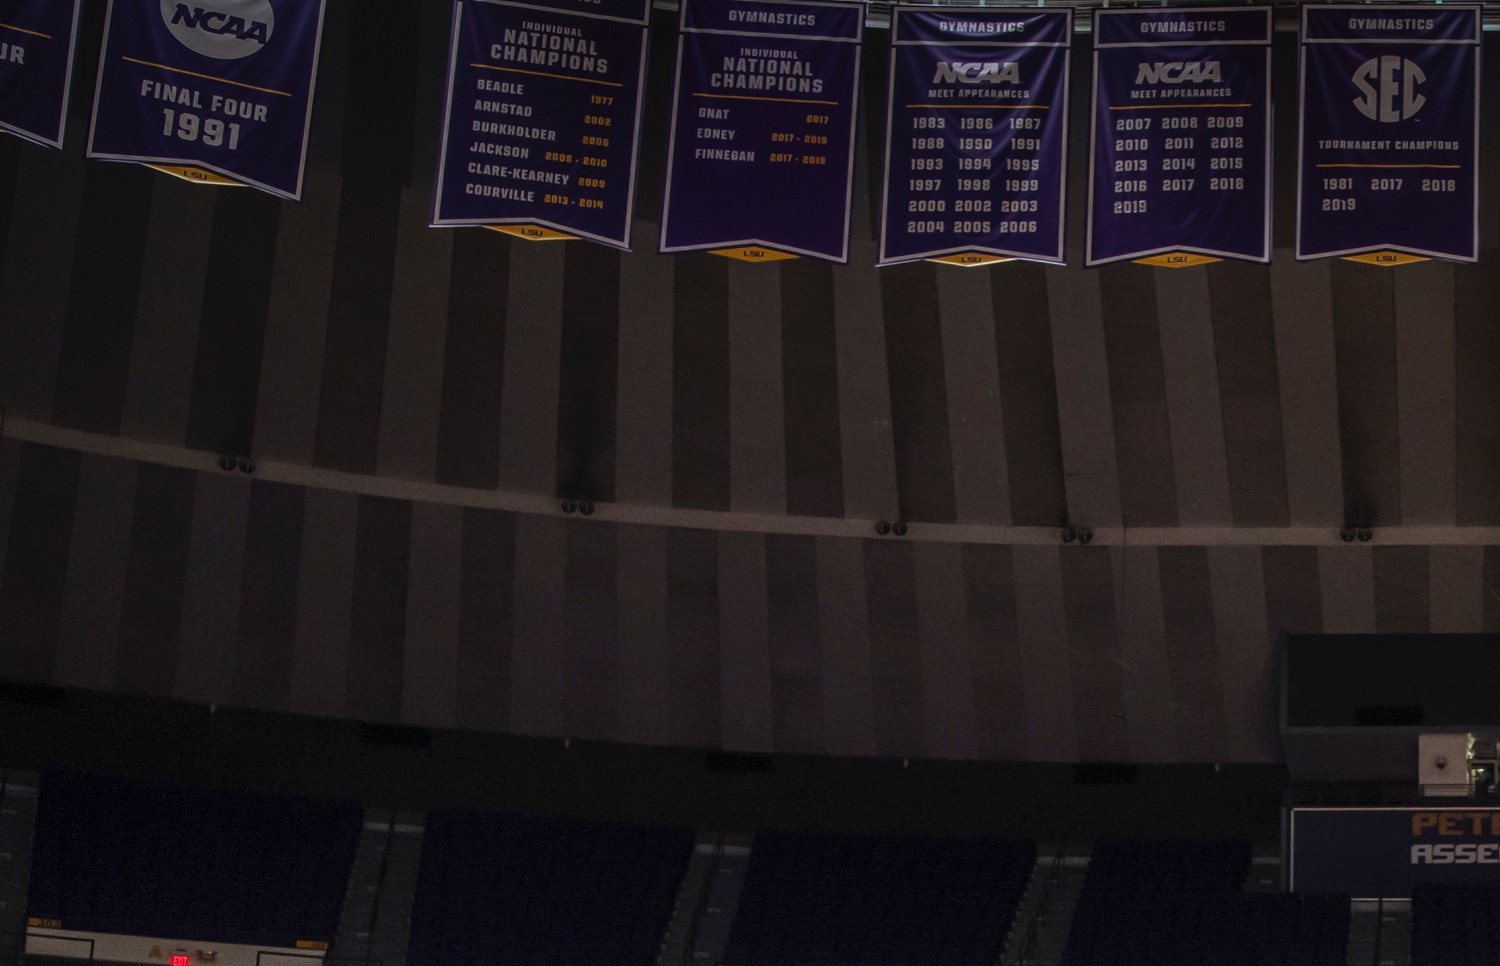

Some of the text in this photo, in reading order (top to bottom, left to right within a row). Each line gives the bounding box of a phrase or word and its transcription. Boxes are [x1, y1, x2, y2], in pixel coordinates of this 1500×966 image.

[171, 4, 269, 44] NCAA
[728, 10, 815, 26] GYMNASTICS
[1348, 18, 1434, 30] GYMNASTICS
[523, 21, 582, 37] INDIVIDUAL
[940, 22, 1025, 33] GYMNASTICS
[1140, 21, 1226, 33] GYMNASTICS
[504, 29, 597, 56] NATIONAL
[490, 44, 608, 74] CHAMPIONS
[740, 48, 798, 59] INDIVIDUAL
[723, 57, 813, 76] NATIONAL
[933, 62, 1020, 84] NCAA
[1135, 61, 1222, 84] NCAA
[710, 73, 823, 93] CHAMPIONS
[1352, 55, 1427, 123] SEC
[477, 79, 613, 106] BEADLE 1977
[928, 89, 1029, 99] MEET APPEARANCES
[1131, 88, 1231, 99] MEET APPEARANCES
[141, 79, 267, 122] FINAL FOUR
[474, 100, 611, 126] ARNSTAD 2002
[698, 107, 730, 120] GNAT
[163, 108, 240, 150] 1991
[913, 117, 1041, 130] 1983 1986 1987
[1116, 116, 1244, 130] 2007 2008 2009
[472, 121, 556, 141] BURKHOLDER
[697, 128, 735, 140] EDNEY
[912, 138, 1040, 150] 1988 1990 1991
[1115, 137, 1243, 151] 2010 2011 2012
[1319, 140, 1459, 151] TOURNAMENT CHAMPIONS
[470, 142, 529, 159] JACKSON
[583, 157, 607, 168] 2010
[695, 149, 755, 162] FINNEGAN
[911, 159, 1040, 171] 1993 1994 1995
[1115, 158, 1243, 172] 2013 2014 2015
[468, 162, 605, 188] CLARE-KEARNEY 2009
[910, 179, 1039, 192] 1997 1998 1999
[1114, 178, 1244, 192] 2016 2017 2018
[1323, 178, 1456, 192] 1981 2017 2018
[466, 184, 604, 209] COURVILLE 2013 2014
[909, 200, 1038, 212] 2000 2002 2003
[1114, 200, 1147, 213] 2019
[1322, 199, 1356, 211] 2019
[907, 221, 1037, 233] 2004 2005 2006
[173, 956, 188, 966] EXIT
